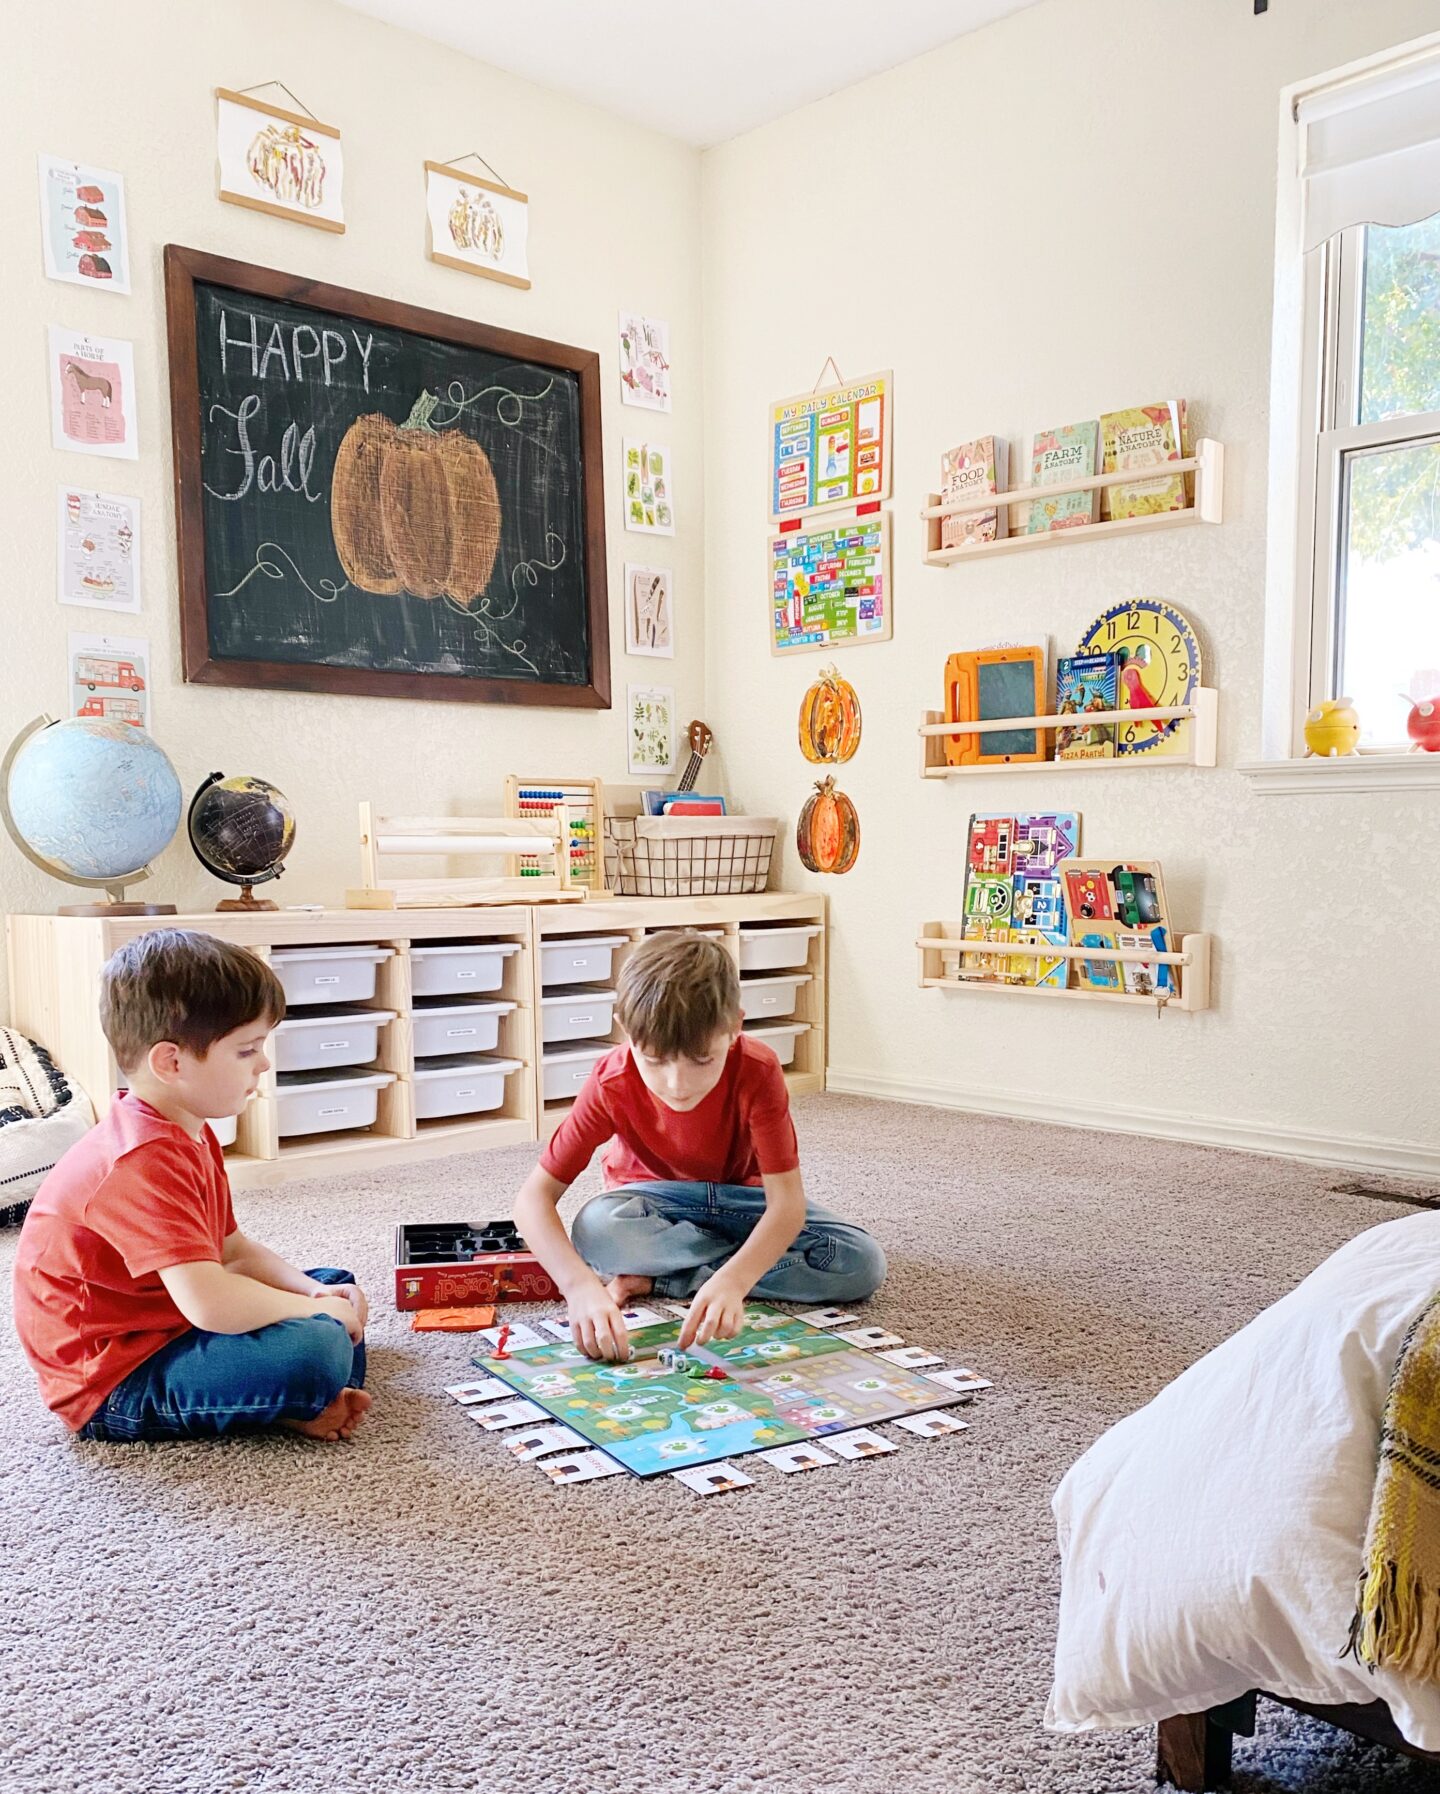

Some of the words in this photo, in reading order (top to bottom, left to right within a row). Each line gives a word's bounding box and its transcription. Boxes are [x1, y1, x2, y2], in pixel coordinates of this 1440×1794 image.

[81, 351, 105, 361] HORSE
[219, 310, 374, 394] HAPPY
[783, 408, 797, 419] MY
[801, 399, 827, 414] DAILY
[830, 385, 877, 406] CALENDAR
[1118, 428, 1162, 446] NATURE
[1119, 438, 1162, 453] ANATOMY
[203, 395, 322, 502] Fall
[1044, 445, 1083, 463] FARM
[1044, 456, 1083, 470] ANATOMY
[951, 467, 985, 486] FOOD
[951, 477, 984, 493] ANATOMY
[92, 510, 122, 520] ANATOMY
[95, 502, 121, 513] SUNDAE
[1126, 611, 1140, 630] 12
[1154, 616, 1159, 634] 1
[1106, 621, 1116, 640] 11
[1171, 634, 1181, 654] 2
[1063, 661, 1069, 670] 2
[1177, 662, 1188, 681] 3
[1125, 725, 1136, 743] 6
[1059, 751, 1079, 760] PIZZA
[1037, 901, 1047, 909] 2
[583, 1454, 611, 1474] SUSPECT
[677, 1463, 728, 1478] SUSPECT
